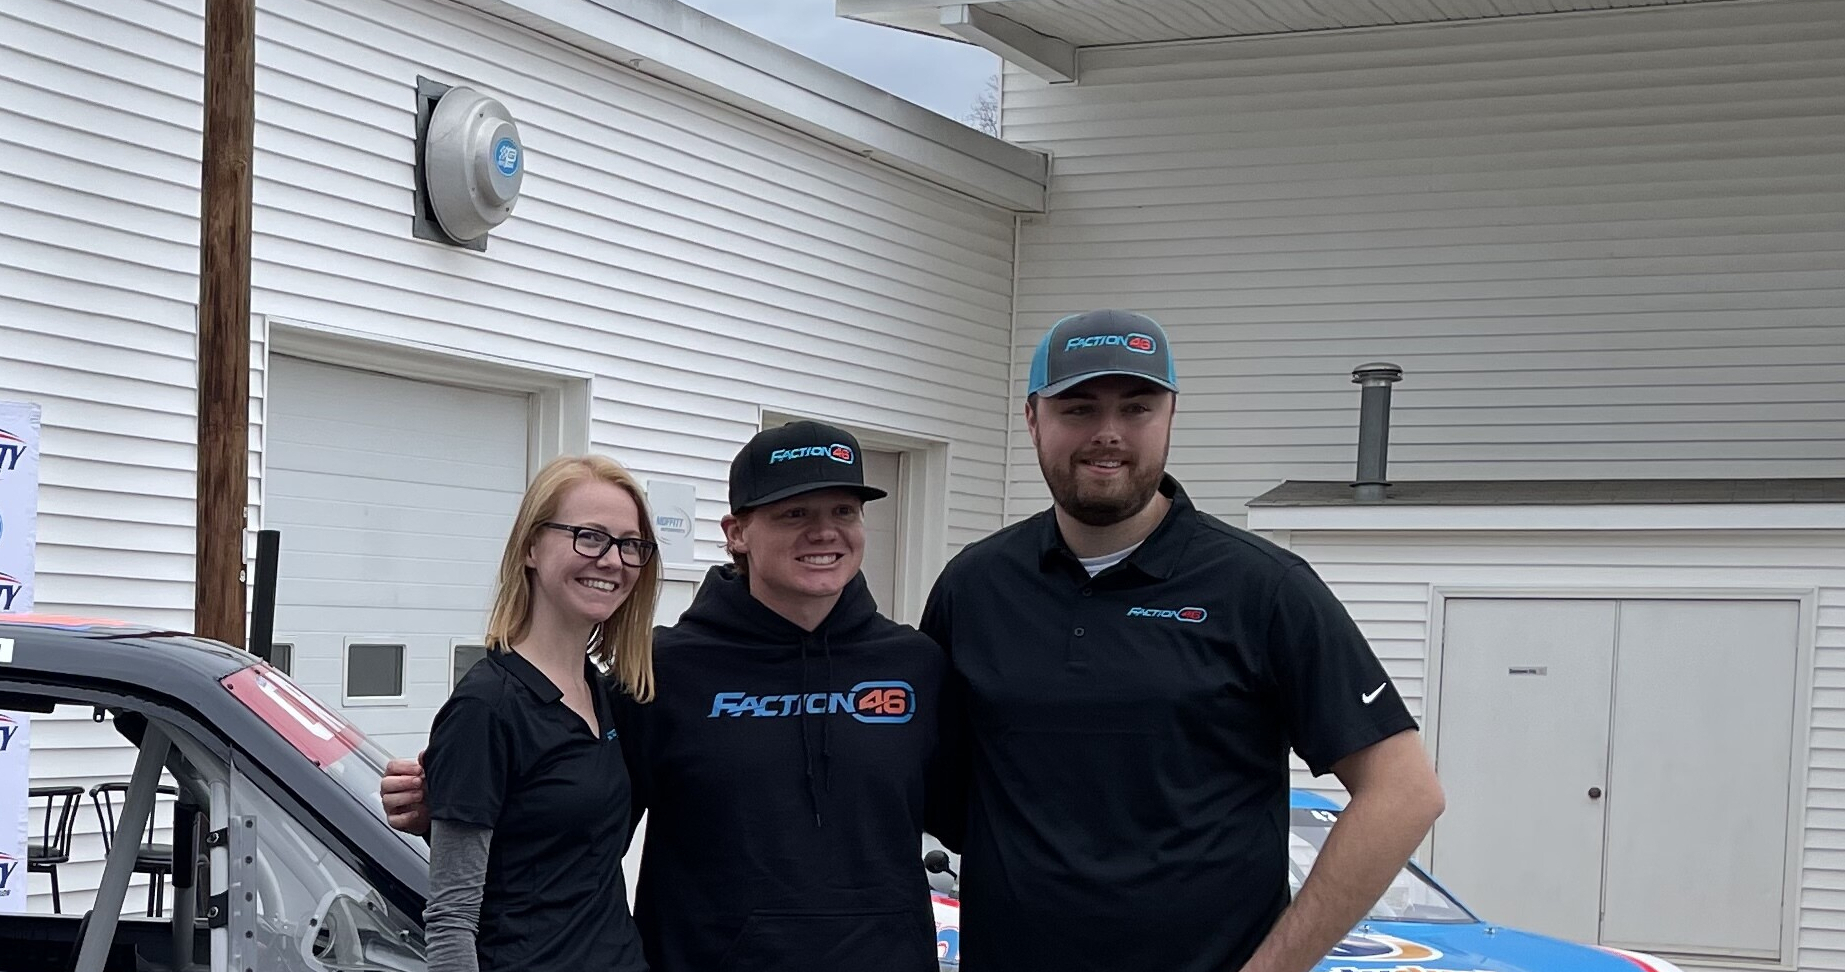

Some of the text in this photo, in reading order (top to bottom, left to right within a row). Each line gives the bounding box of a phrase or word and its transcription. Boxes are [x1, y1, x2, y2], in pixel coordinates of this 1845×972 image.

[1065, 335, 1150, 352] FACTION 46
[769, 446, 850, 465] FACTION 46
[707, 689, 907, 718] FACTION 46
